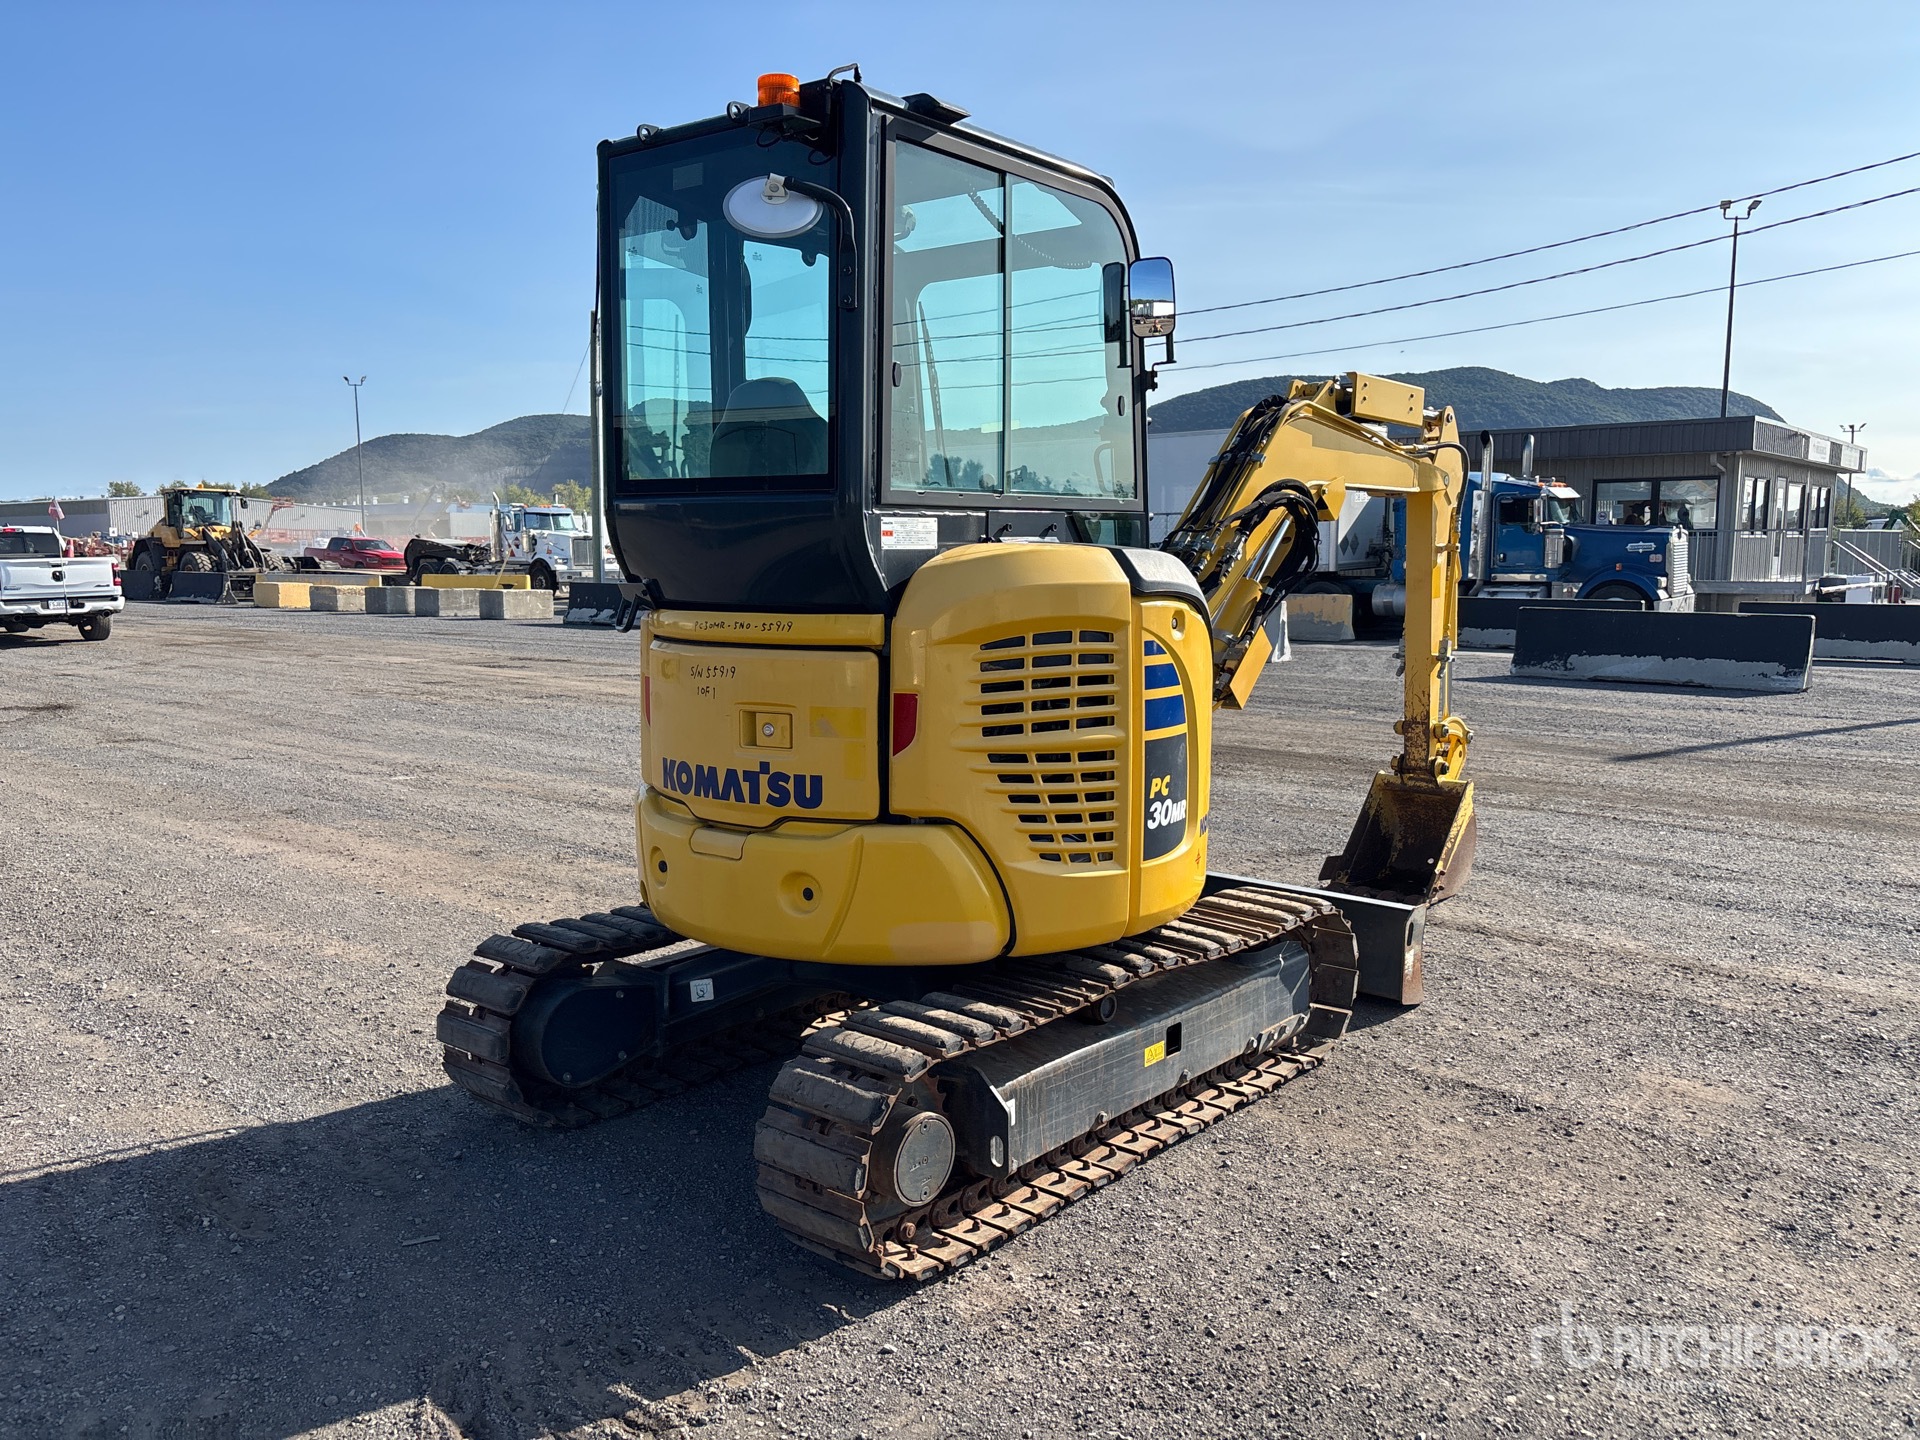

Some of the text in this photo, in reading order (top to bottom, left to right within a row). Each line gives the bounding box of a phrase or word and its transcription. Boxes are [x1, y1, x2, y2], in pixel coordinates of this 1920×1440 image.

[705, 665, 736, 679] 55919
[662, 757, 823, 809] KOMATSU
[1149, 774, 1171, 799] PC
[1147, 798, 1186, 829] 30MR
